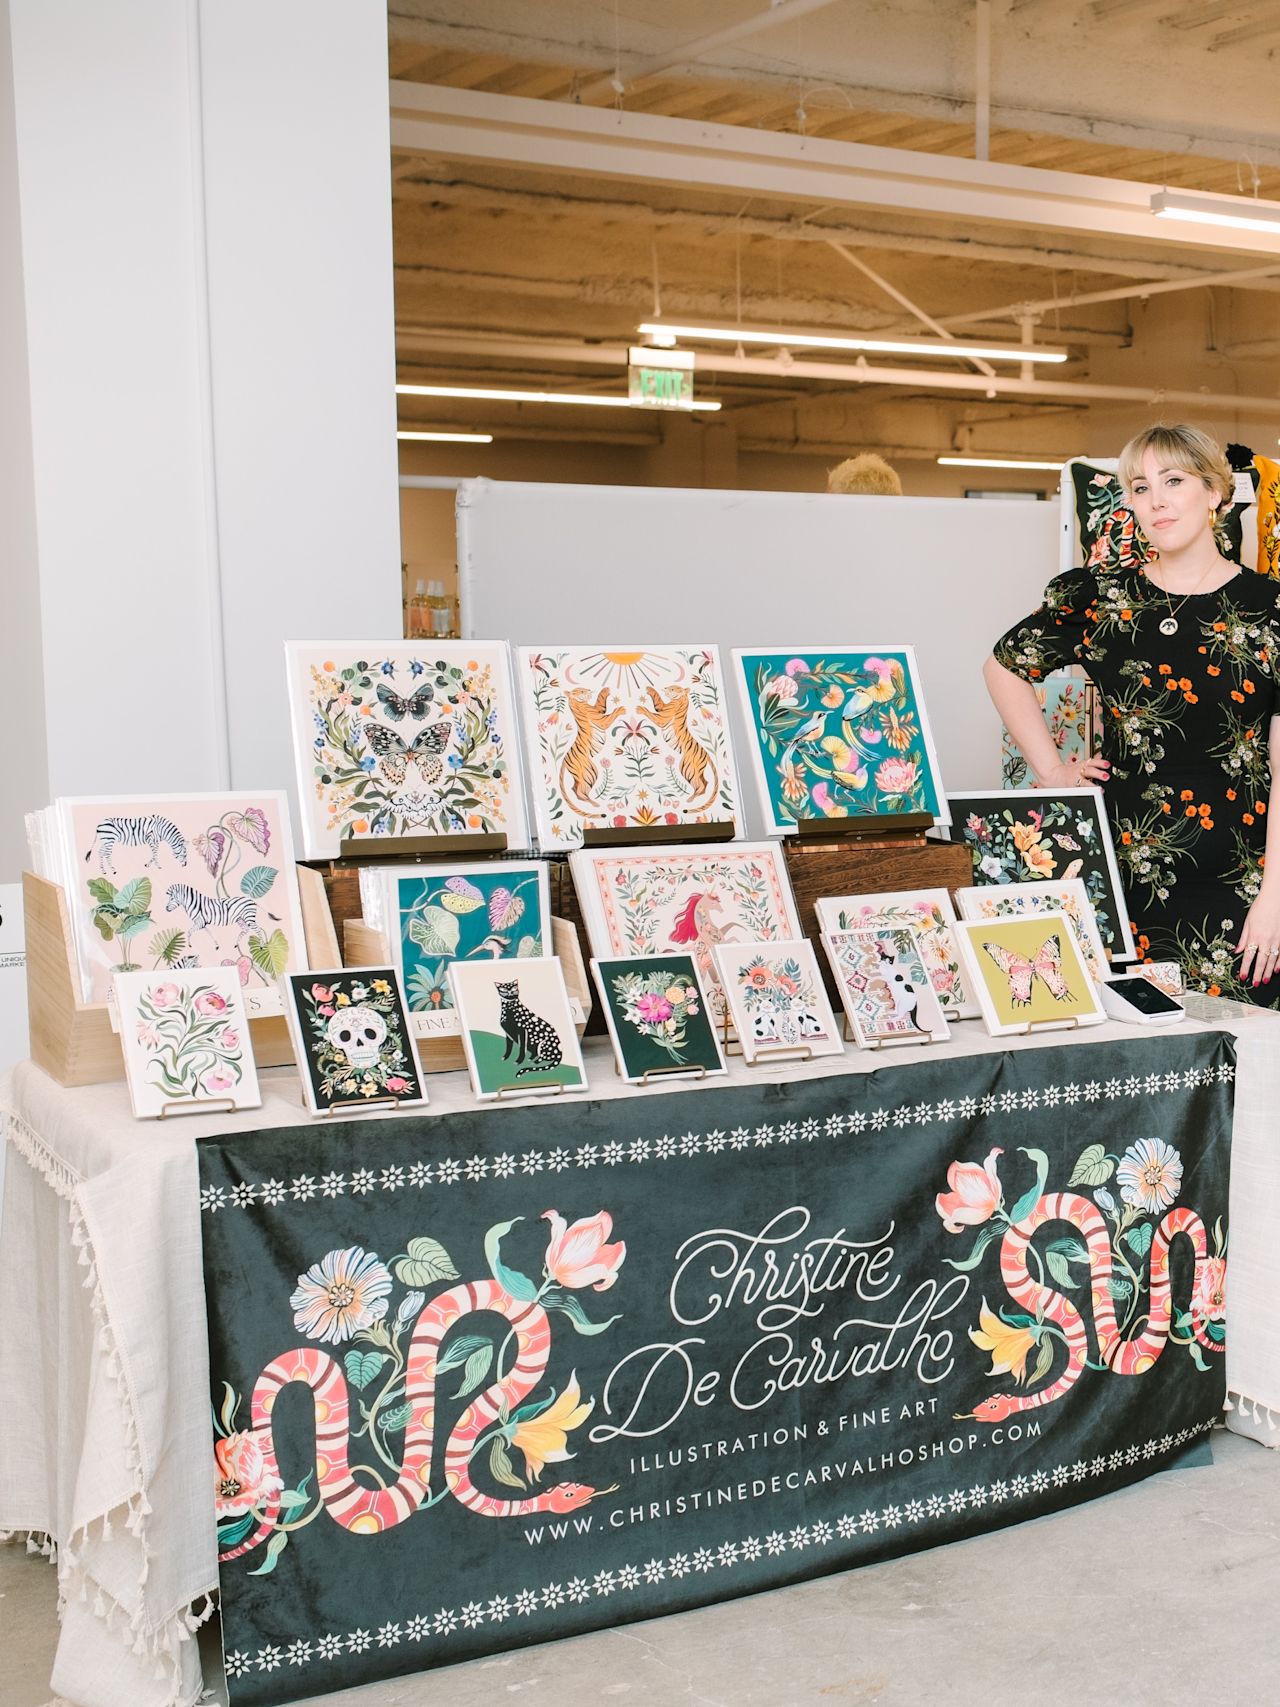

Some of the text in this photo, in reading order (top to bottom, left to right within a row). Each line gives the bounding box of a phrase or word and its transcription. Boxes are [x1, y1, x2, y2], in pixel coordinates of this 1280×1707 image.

[641, 369, 684, 401] EXIT
[417, 1017, 450, 1031] FINE
[670, 1206, 901, 1331] Christine
[589, 1275, 970, 1443] De Carvalho
[524, 1421, 1042, 1546] WWW.CHRISTINEDECARVALHOSHOP.COM
[630, 1398, 938, 1474] ILLUSTRATION & FINE ART
